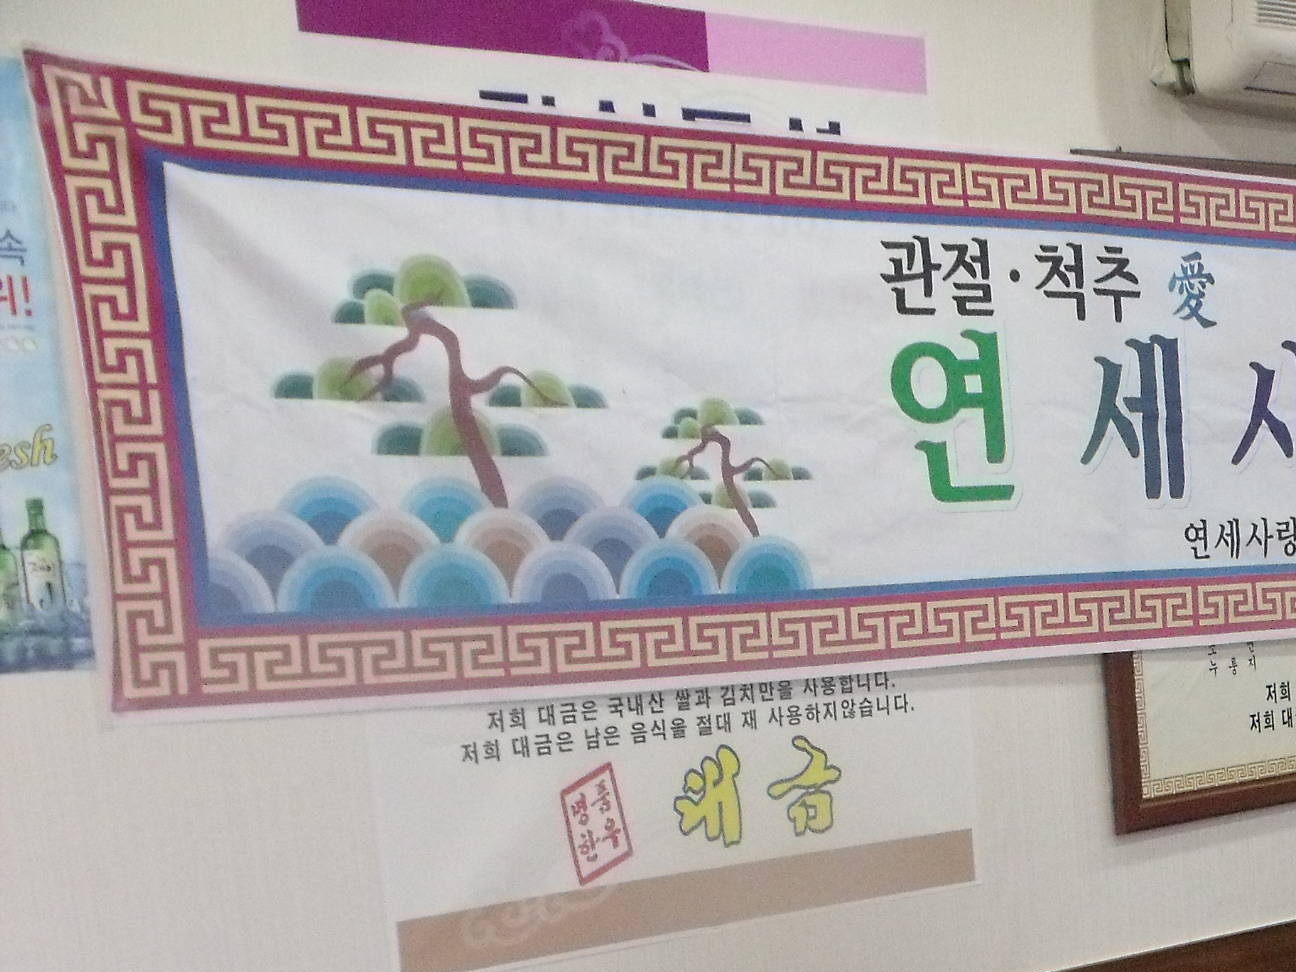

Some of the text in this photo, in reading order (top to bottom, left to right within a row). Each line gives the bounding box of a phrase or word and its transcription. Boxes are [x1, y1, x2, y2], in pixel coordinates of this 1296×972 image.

[1168, 251, 1217, 329] 愛
[488, 671, 895, 732] 저희 대금은 국내산 쌀과 김치만을 사용합니다.
[1265, 681, 1291, 703] 저희
[461, 739, 501, 764] 저희
[511, 731, 574, 758] 대금은
[585, 725, 621, 750] 남은
[630, 717, 687, 744] 음식을
[696, 712, 731, 736] 절대
[742, 709, 758, 730] 재
[1250, 710, 1275, 733] 저희
